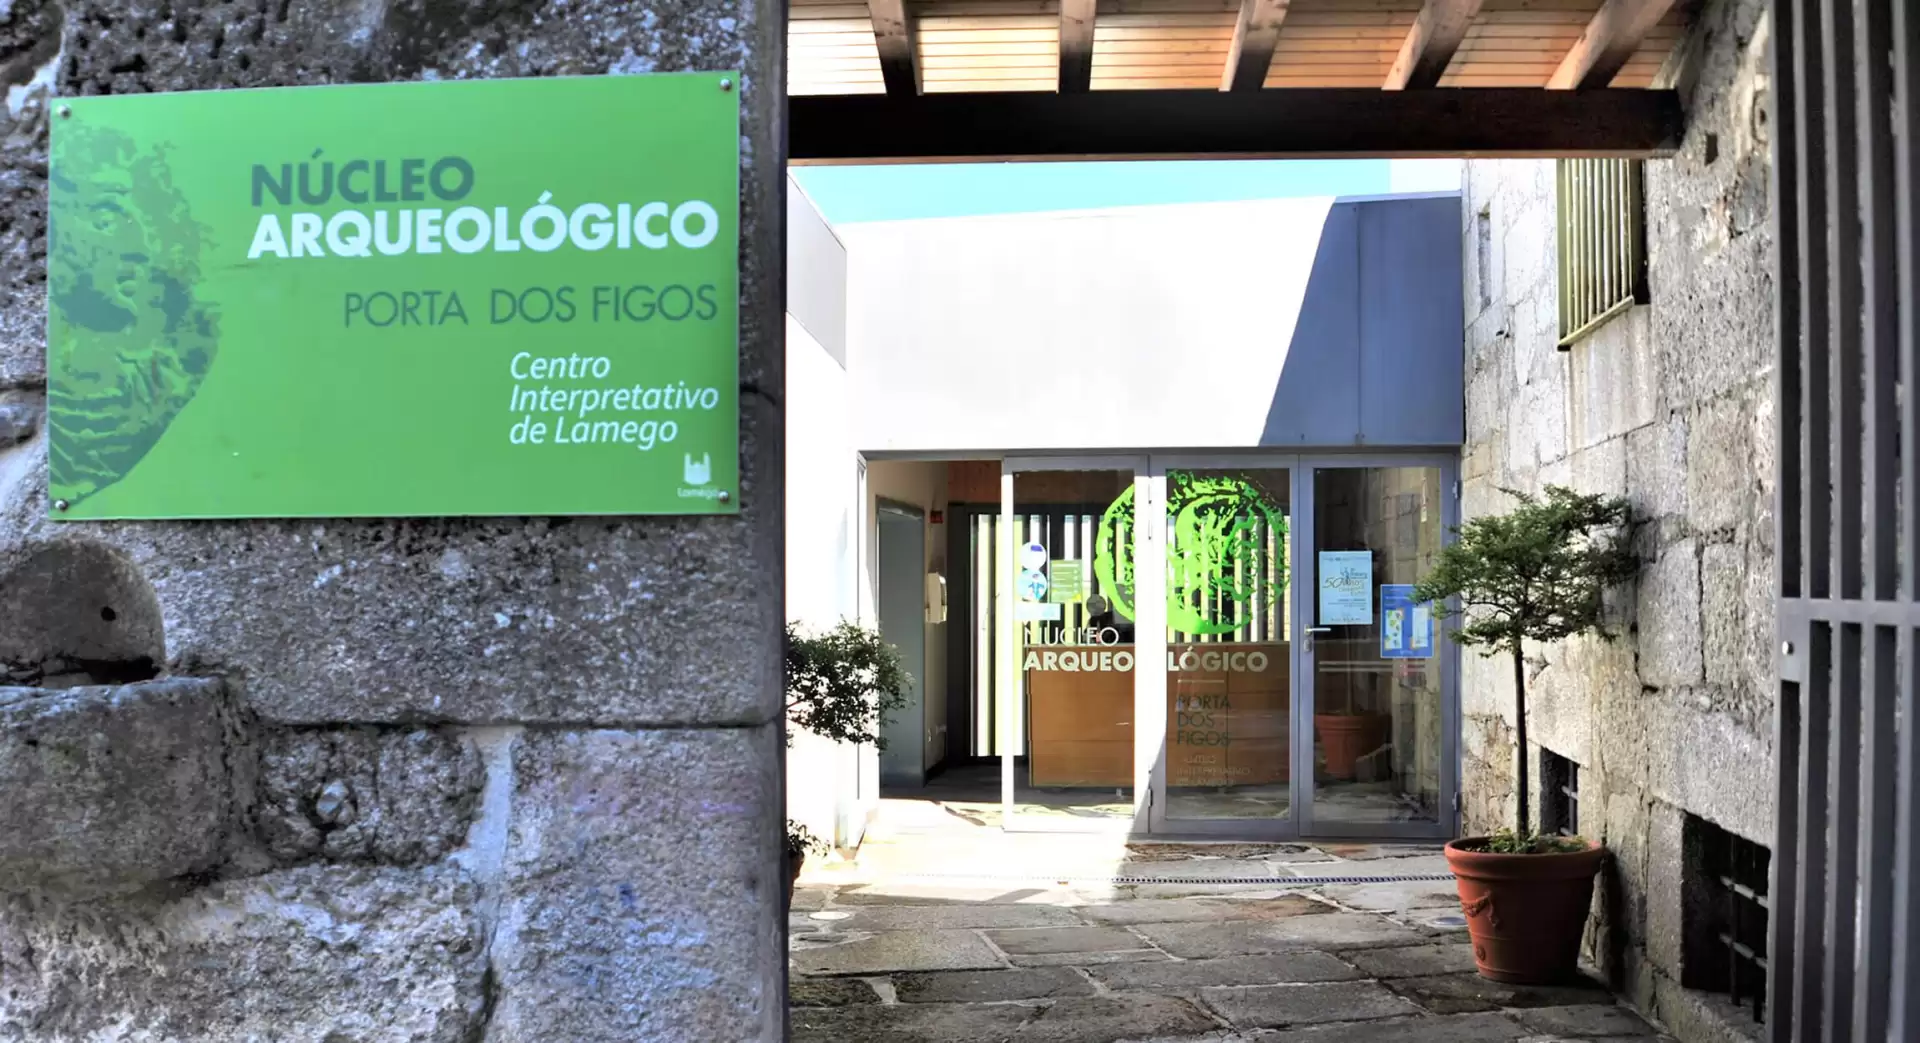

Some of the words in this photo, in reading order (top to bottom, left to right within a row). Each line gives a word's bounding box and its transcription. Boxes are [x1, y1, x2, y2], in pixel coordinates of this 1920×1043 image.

[251, 147, 475, 207] NÚCLEO
[247, 190, 719, 259] ARQUEOLÓGICO
[344, 290, 469, 328] PORTA
[490, 286, 577, 324] DOS
[592, 284, 718, 322] FIGOS
[510, 351, 611, 380] Centro
[509, 380, 719, 419] Interpretativo
[509, 414, 547, 444] de
[555, 415, 678, 451] Lamego
[1176, 695, 1231, 710] PORTA
[1177, 712, 1215, 728] DOS
[1176, 730, 1231, 746] FIGOS
